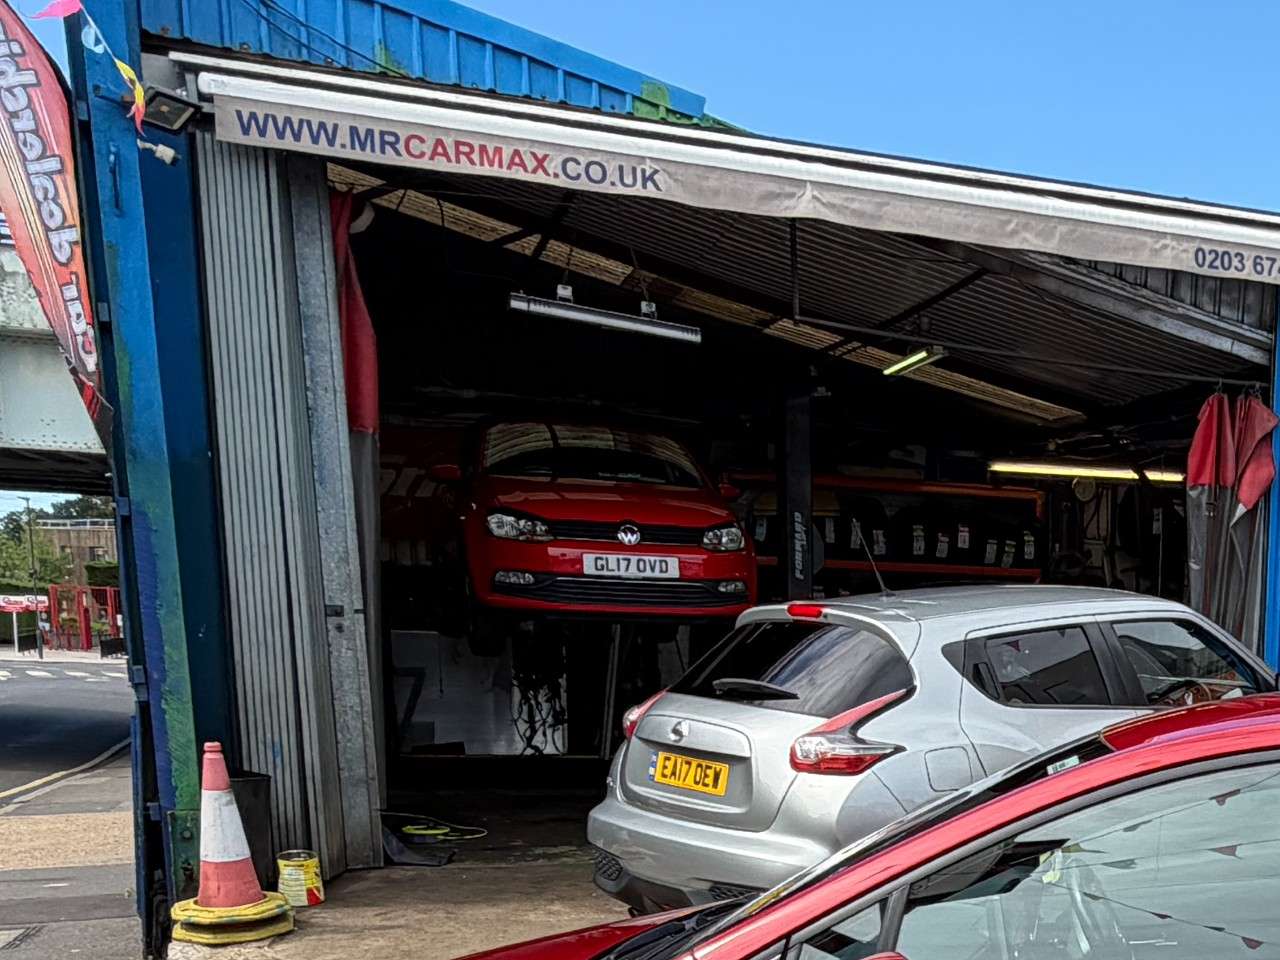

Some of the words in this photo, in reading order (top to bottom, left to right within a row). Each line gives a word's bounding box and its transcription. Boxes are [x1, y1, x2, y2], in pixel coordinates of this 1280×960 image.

[235, 109, 662, 192] WWW.MRCARMAX.CO.UK
[1195, 247, 1245, 272] 0203
[594, 556, 631, 573] GL17
[636, 557, 669, 574] OVD
[660, 755, 692, 783] EA17
[693, 762, 723, 790] OEW
